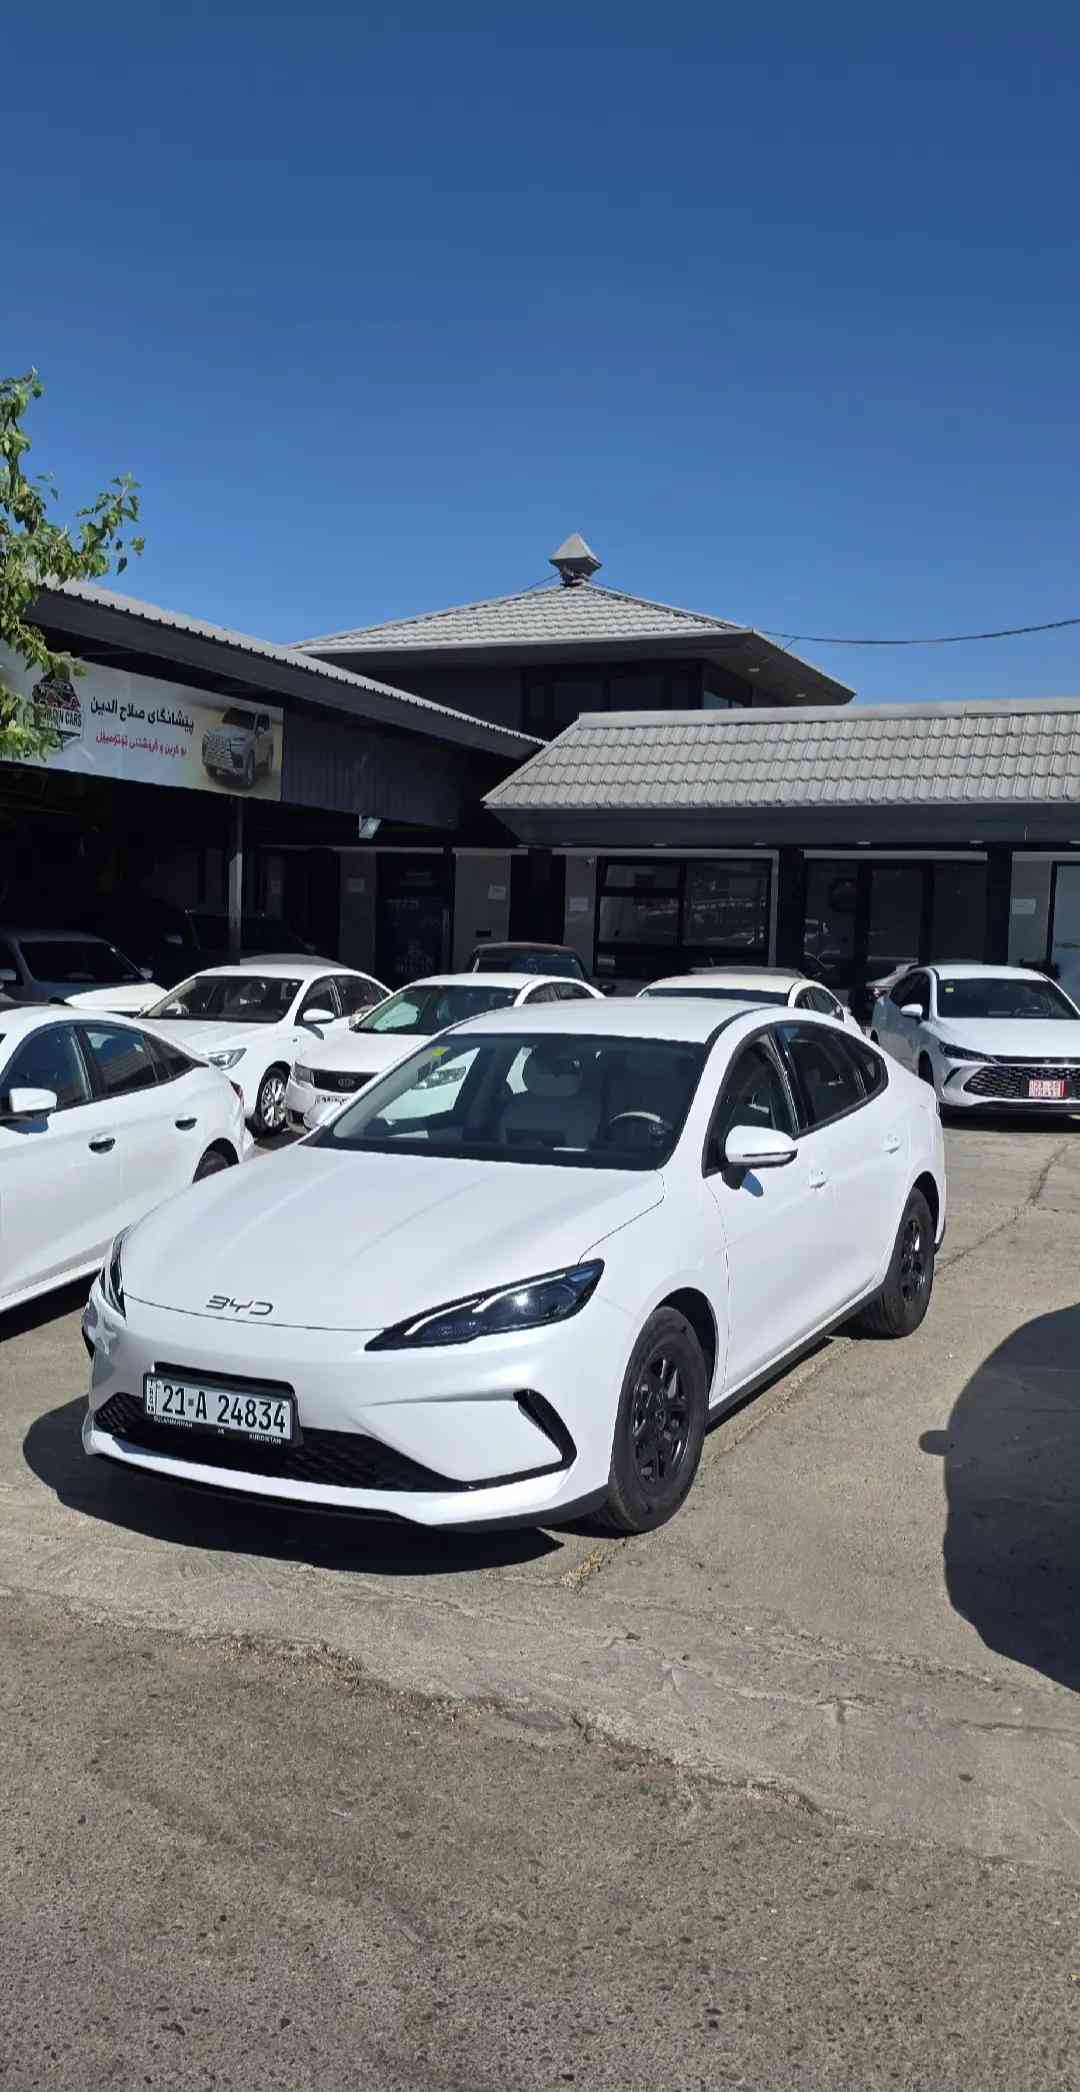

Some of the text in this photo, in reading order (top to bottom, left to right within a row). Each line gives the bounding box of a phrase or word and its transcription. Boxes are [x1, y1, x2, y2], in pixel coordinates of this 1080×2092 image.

[65, 710, 82, 729] CARS
[120, 703, 146, 722] صلاح
[205, 1295, 274, 1316] BYD
[216, 1394, 286, 1433] 24834
